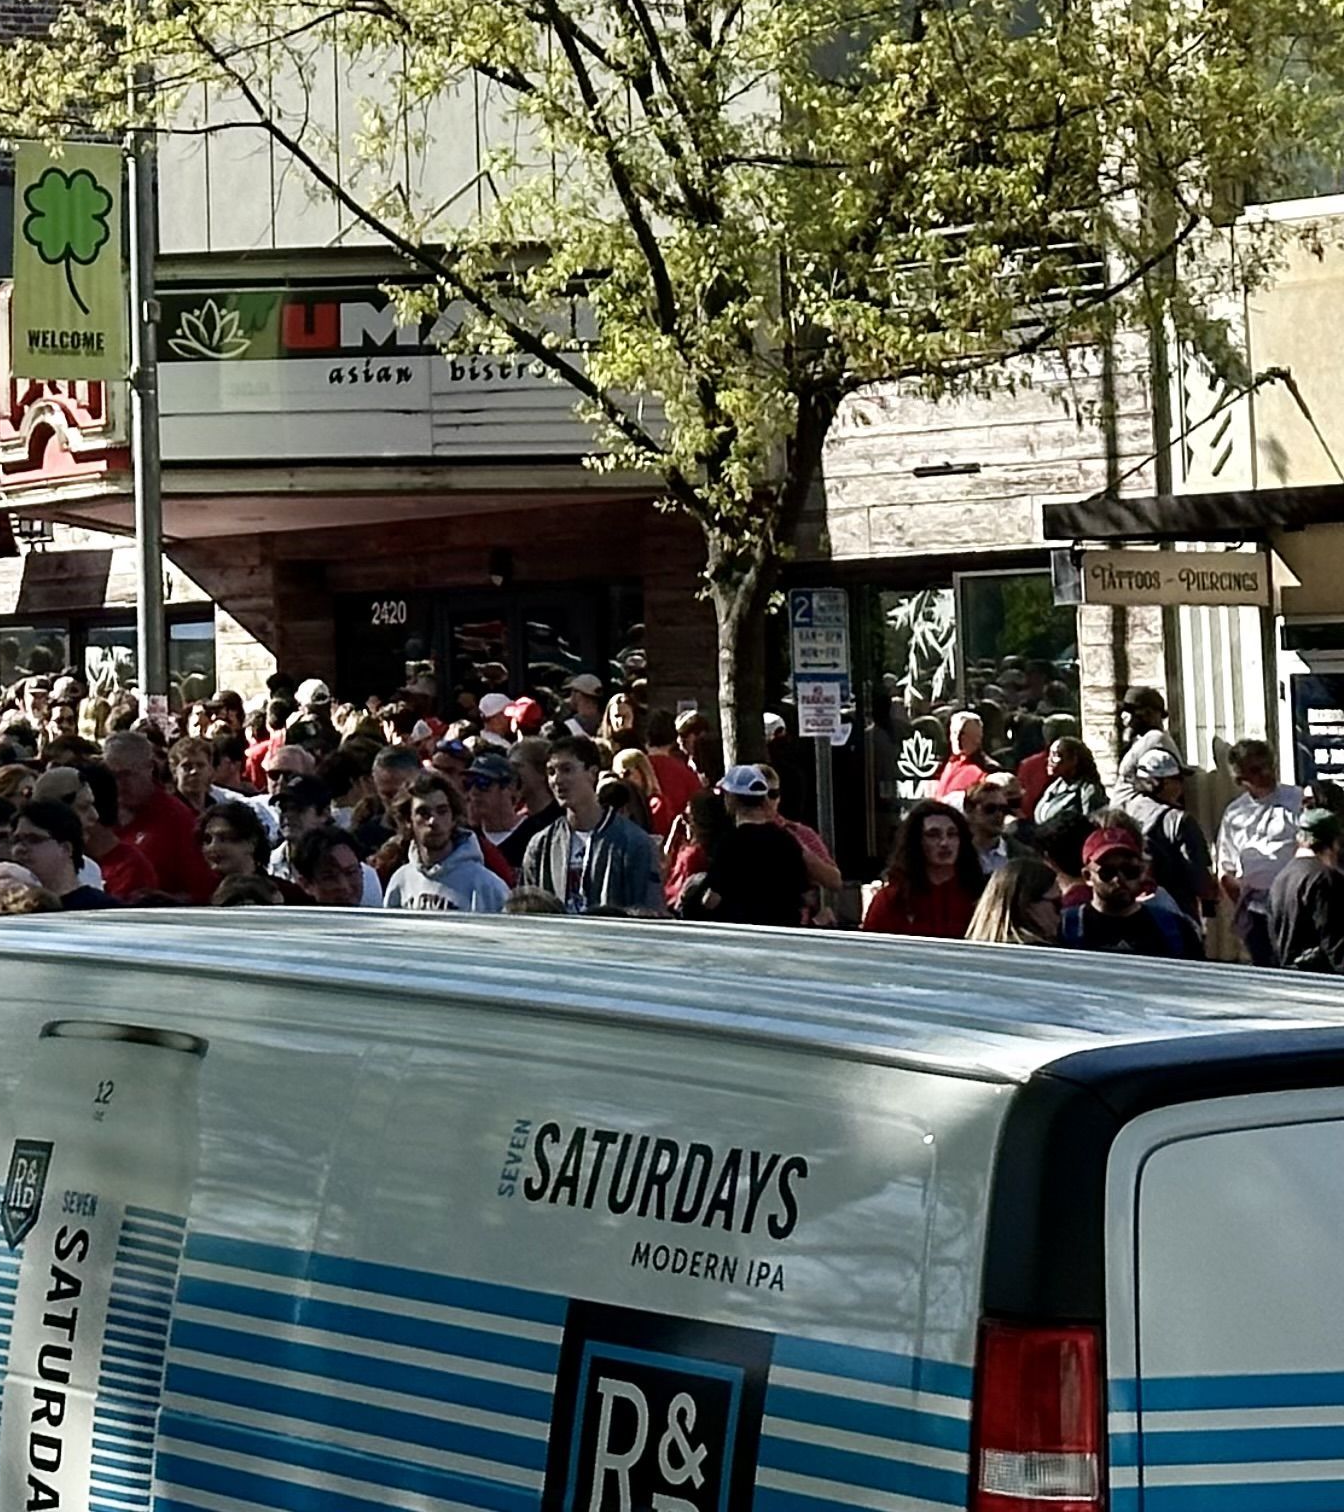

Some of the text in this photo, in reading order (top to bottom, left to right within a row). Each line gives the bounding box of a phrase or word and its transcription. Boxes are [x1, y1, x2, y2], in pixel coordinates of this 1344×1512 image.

[27, 329, 105, 351] WELCOME
[328, 358, 413, 385] asian
[371, 599, 407, 625] 2420
[794, 596, 811, 623] 2
[93, 1079, 115, 1105] 12
[497, 1119, 533, 1198] SEVEN
[523, 1121, 809, 1240] SATURDAYS
[62, 1190, 98, 1218] SEVEN
[630, 1241, 785, 1293] MODERN IPA
[588, 1376, 709, 1512] R&
